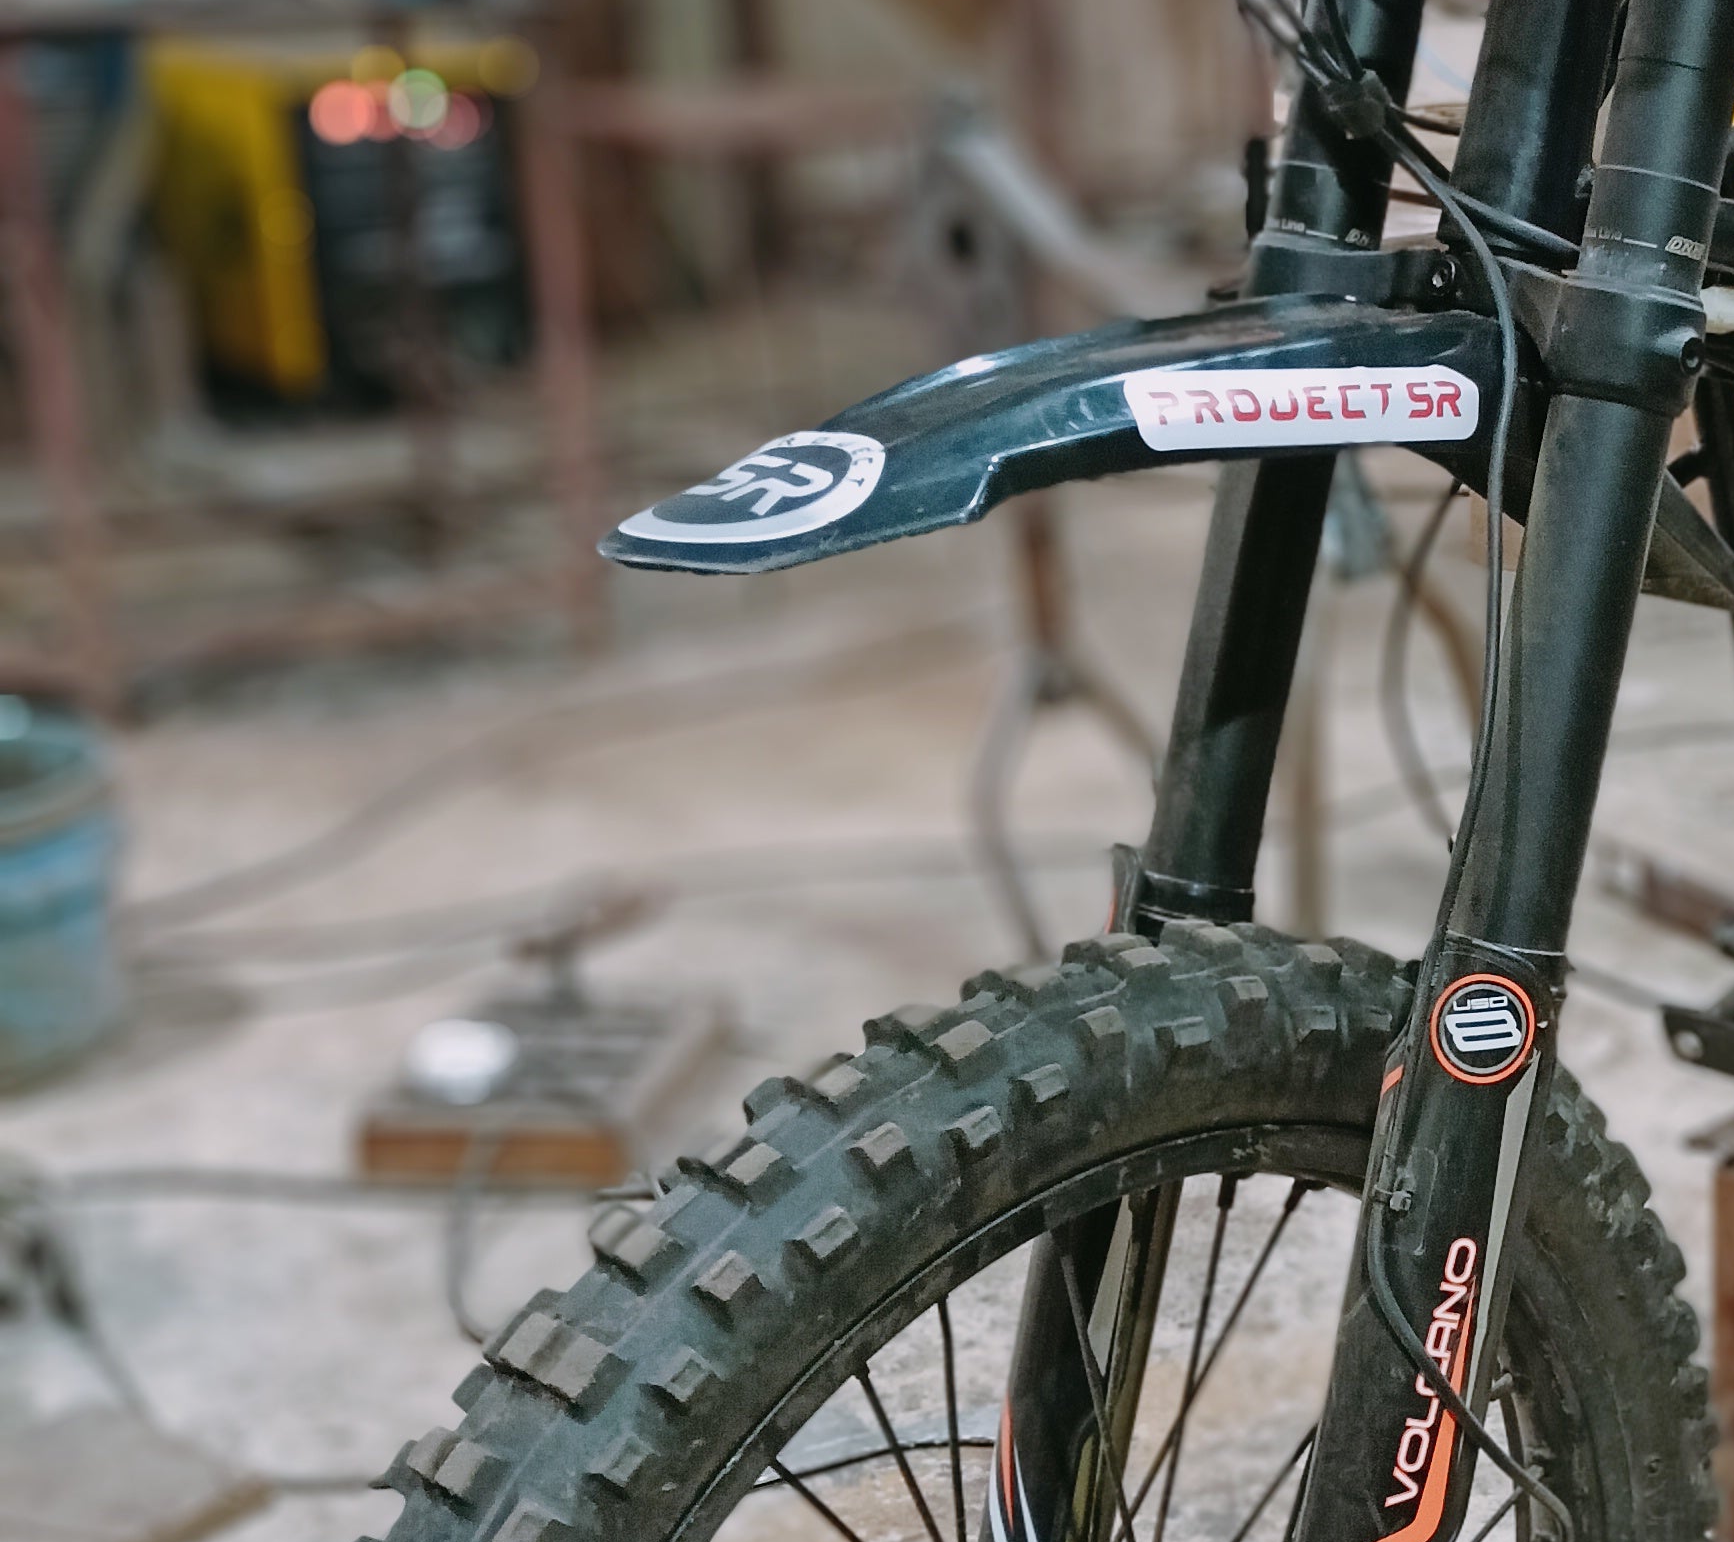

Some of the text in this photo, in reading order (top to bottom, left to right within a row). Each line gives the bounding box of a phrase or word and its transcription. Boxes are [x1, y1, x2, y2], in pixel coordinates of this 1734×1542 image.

[1148, 380, 1462, 426] PROJECT SR
[680, 454, 834, 517] SR
[1452, 995, 1509, 1012] USD
